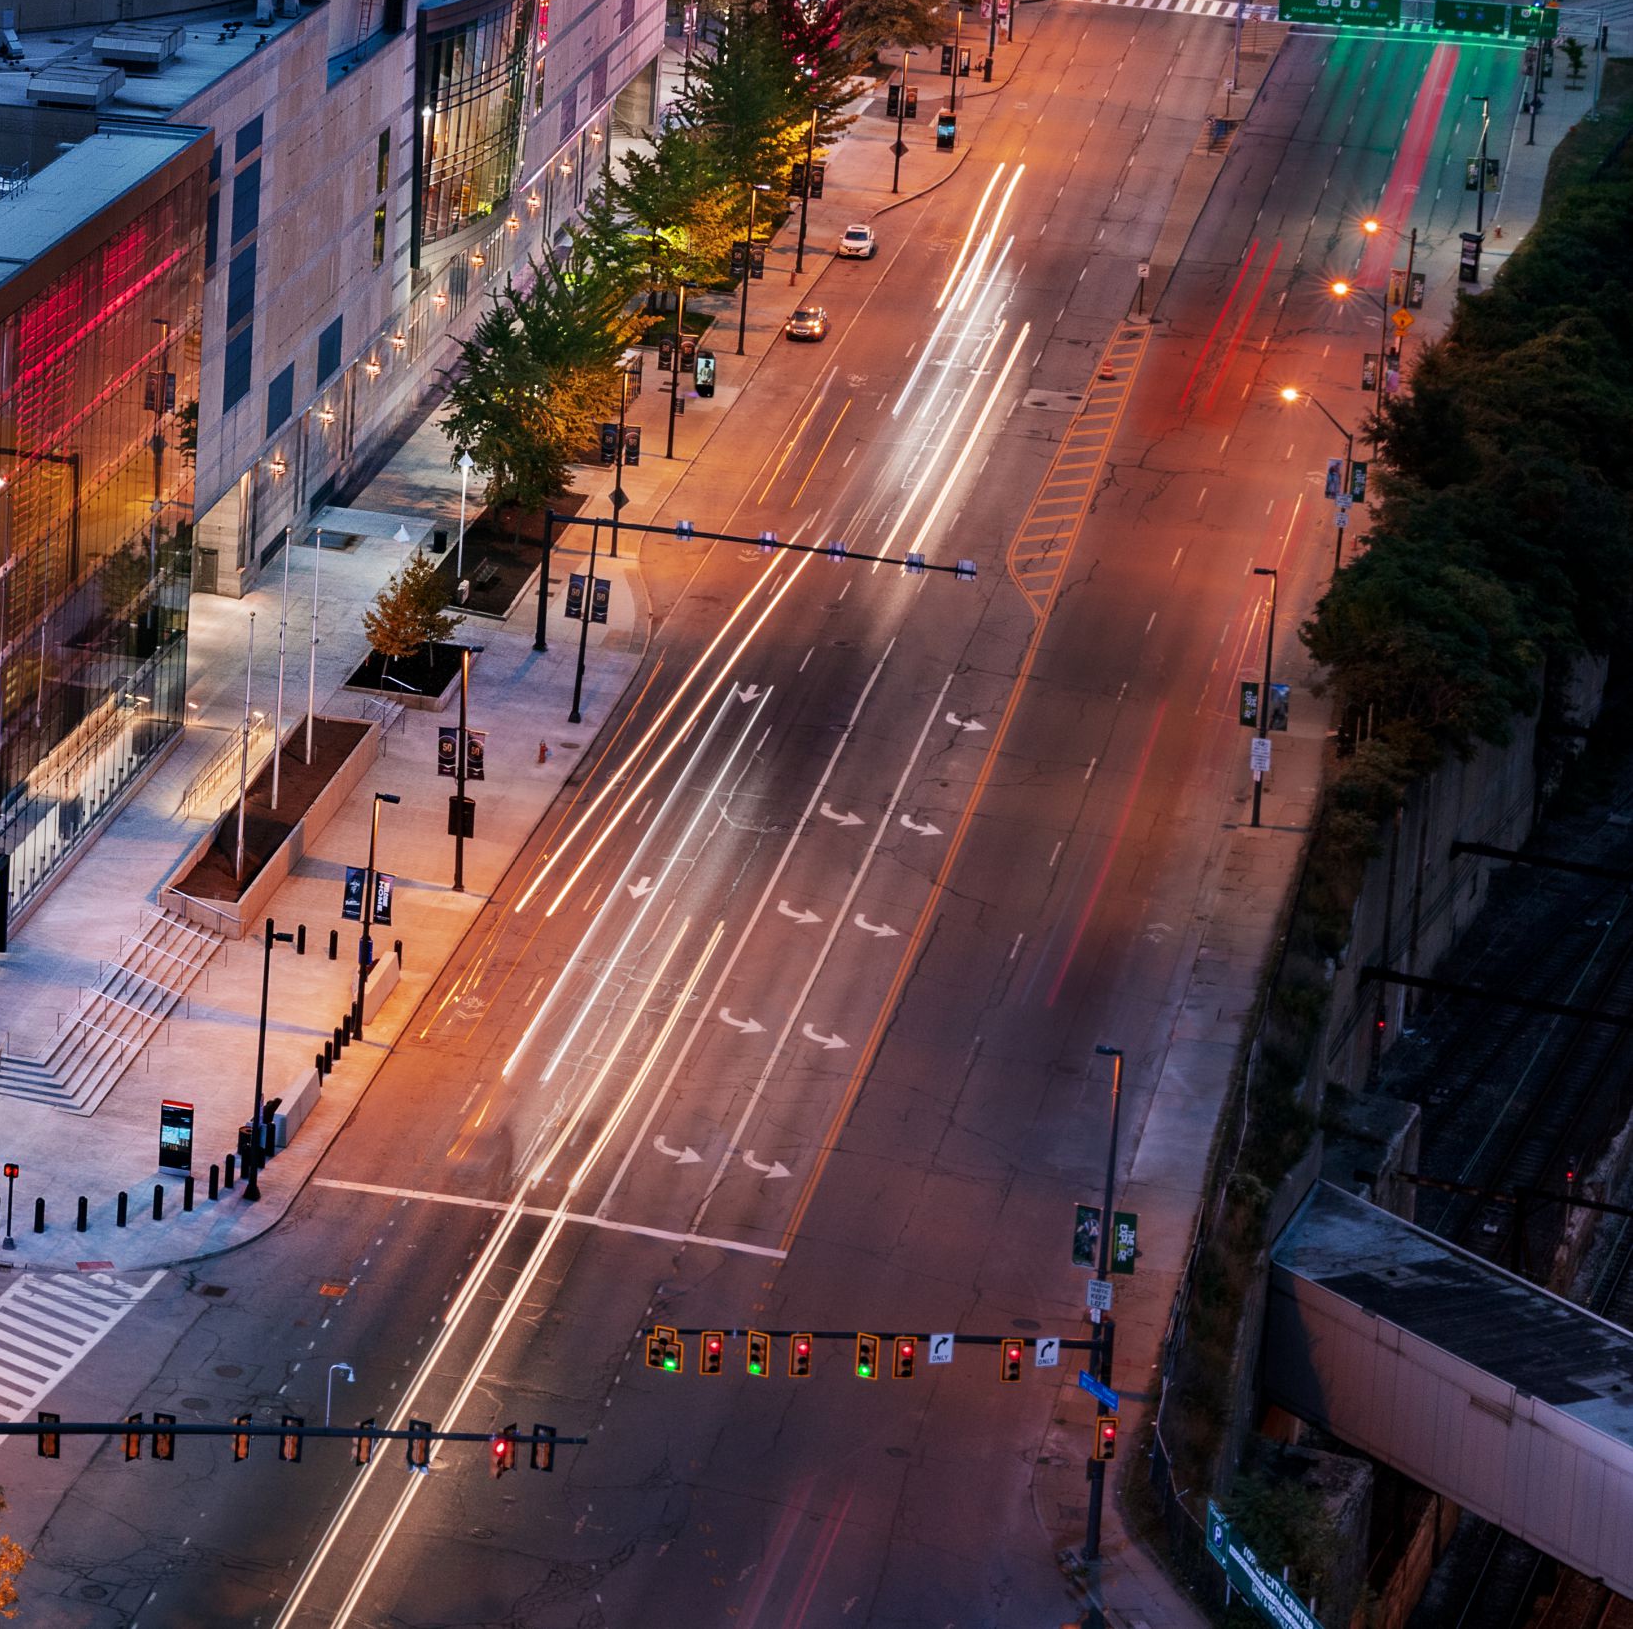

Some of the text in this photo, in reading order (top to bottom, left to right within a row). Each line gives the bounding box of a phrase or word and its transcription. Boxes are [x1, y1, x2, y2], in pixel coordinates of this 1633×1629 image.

[596, 592, 606, 602] 50
[442, 742, 453, 753] 50
[471, 746, 480, 756] 50
[376, 881, 385, 912] HOME
[1091, 1293, 1107, 1301] KEEP
[1090, 1299, 1107, 1308] LEFT
[932, 1354, 949, 1362] ONLY
[1038, 1357, 1054, 1365] ONLY
[1265, 1574, 1284, 1598] CITY
[1284, 1593, 1314, 1629] CENTER
